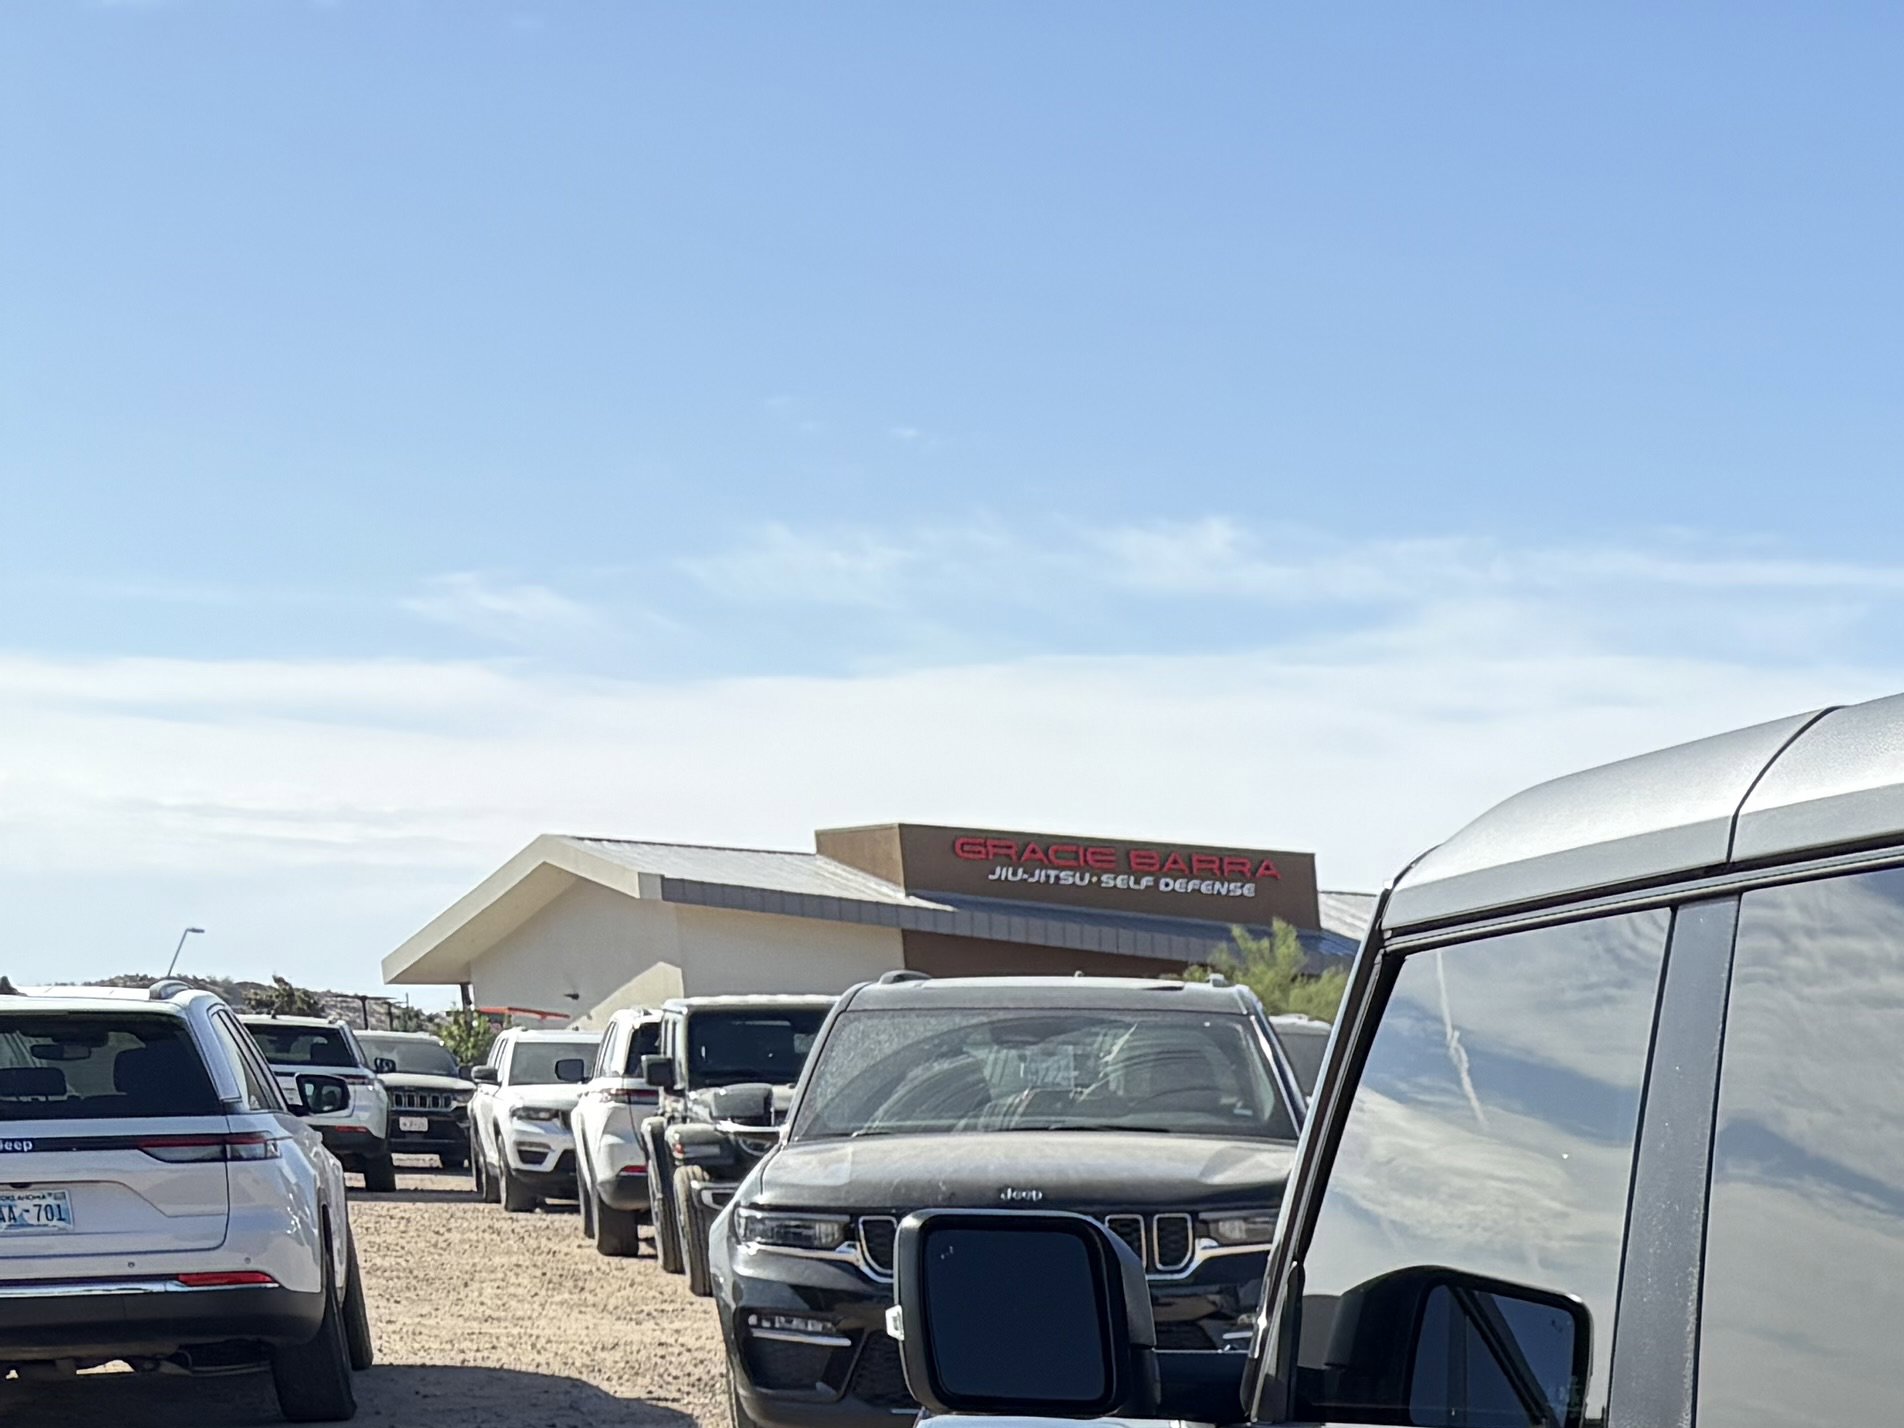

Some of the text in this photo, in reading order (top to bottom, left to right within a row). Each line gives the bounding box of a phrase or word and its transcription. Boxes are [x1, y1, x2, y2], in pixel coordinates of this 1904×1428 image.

[953, 836, 1281, 879] GRACIE BARRA
[1158, 877, 1256, 897] DEFENSE
